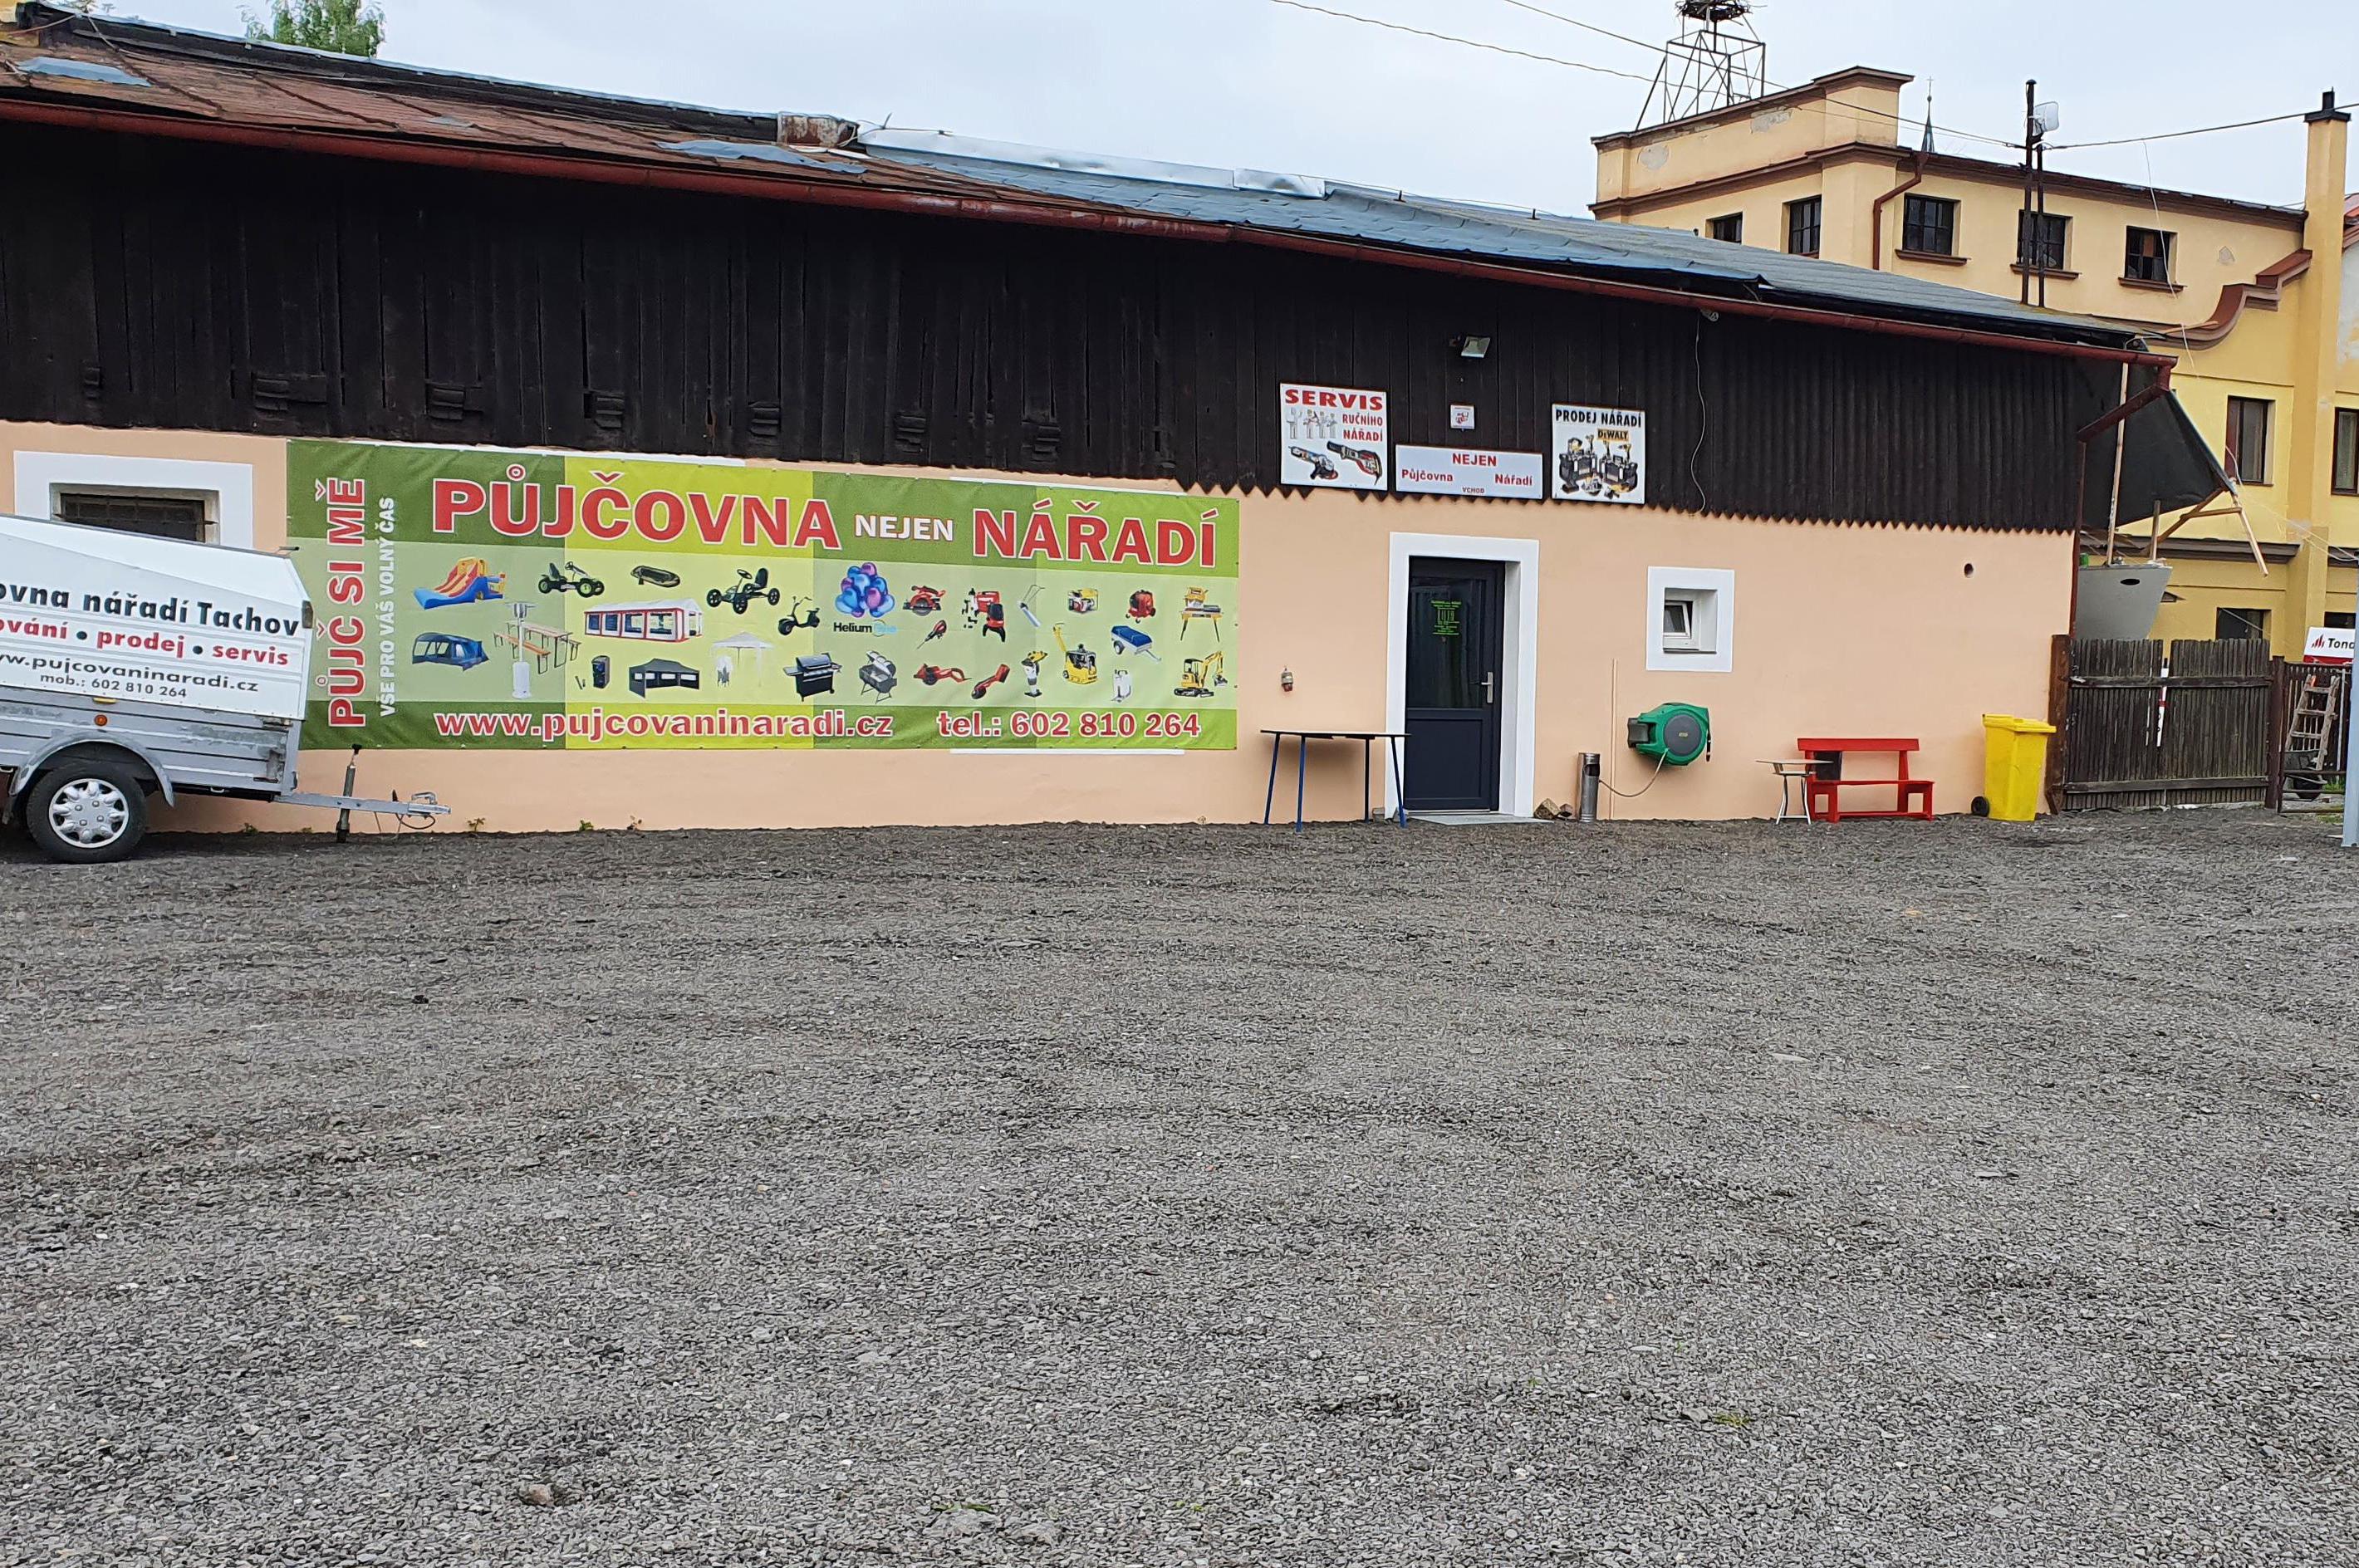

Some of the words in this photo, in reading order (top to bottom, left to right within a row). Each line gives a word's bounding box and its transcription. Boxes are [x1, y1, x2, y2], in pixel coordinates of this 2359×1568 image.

[1285, 389, 1383, 411] SERVIS
[1342, 412, 1383, 427] RUČNÍHO
[1343, 427, 1383, 442] NÁŘADÍ
[1556, 409, 1596, 424] PRODEJ
[1601, 409, 1641, 428] NÁŘADÍ
[1401, 468, 1454, 483] Půjčovna
[1495, 473, 1533, 486] Nářadí
[1452, 453, 1496, 467] NEJEN
[315, 478, 365, 546] MĚ
[375, 497, 395, 533] ČAS
[433, 463, 841, 550] PŮJČOVNA
[855, 515, 954, 541] NEJEN
[973, 498, 1219, 568] NÁŘADÍ
[326, 560, 365, 605] SI
[375, 537, 395, 596] VOLNÝ
[83, 591, 189, 624] nářadí
[198, 601, 299, 636] Tachov
[375, 600, 395, 635] VÁŠ
[833, 622, 872, 633] Helium
[97, 630, 184, 659] prodej
[212, 645, 288, 665] servis
[380, 640, 395, 678] PRO
[41, 674, 86, 687] mob.:
[91, 679, 120, 691] 602
[125, 682, 154, 694] 810
[159, 686, 187, 698] 264
[315, 615, 366, 728] PŮJČ
[375, 682, 396, 717] VŠE
[434, 708, 893, 742] www.pujcovaninaradi.cz
[937, 711, 1002, 737] tel.:
[1010, 712, 1069, 737] 602
[1079, 713, 1135, 737] 810
[1144, 712, 1201, 737] 264
